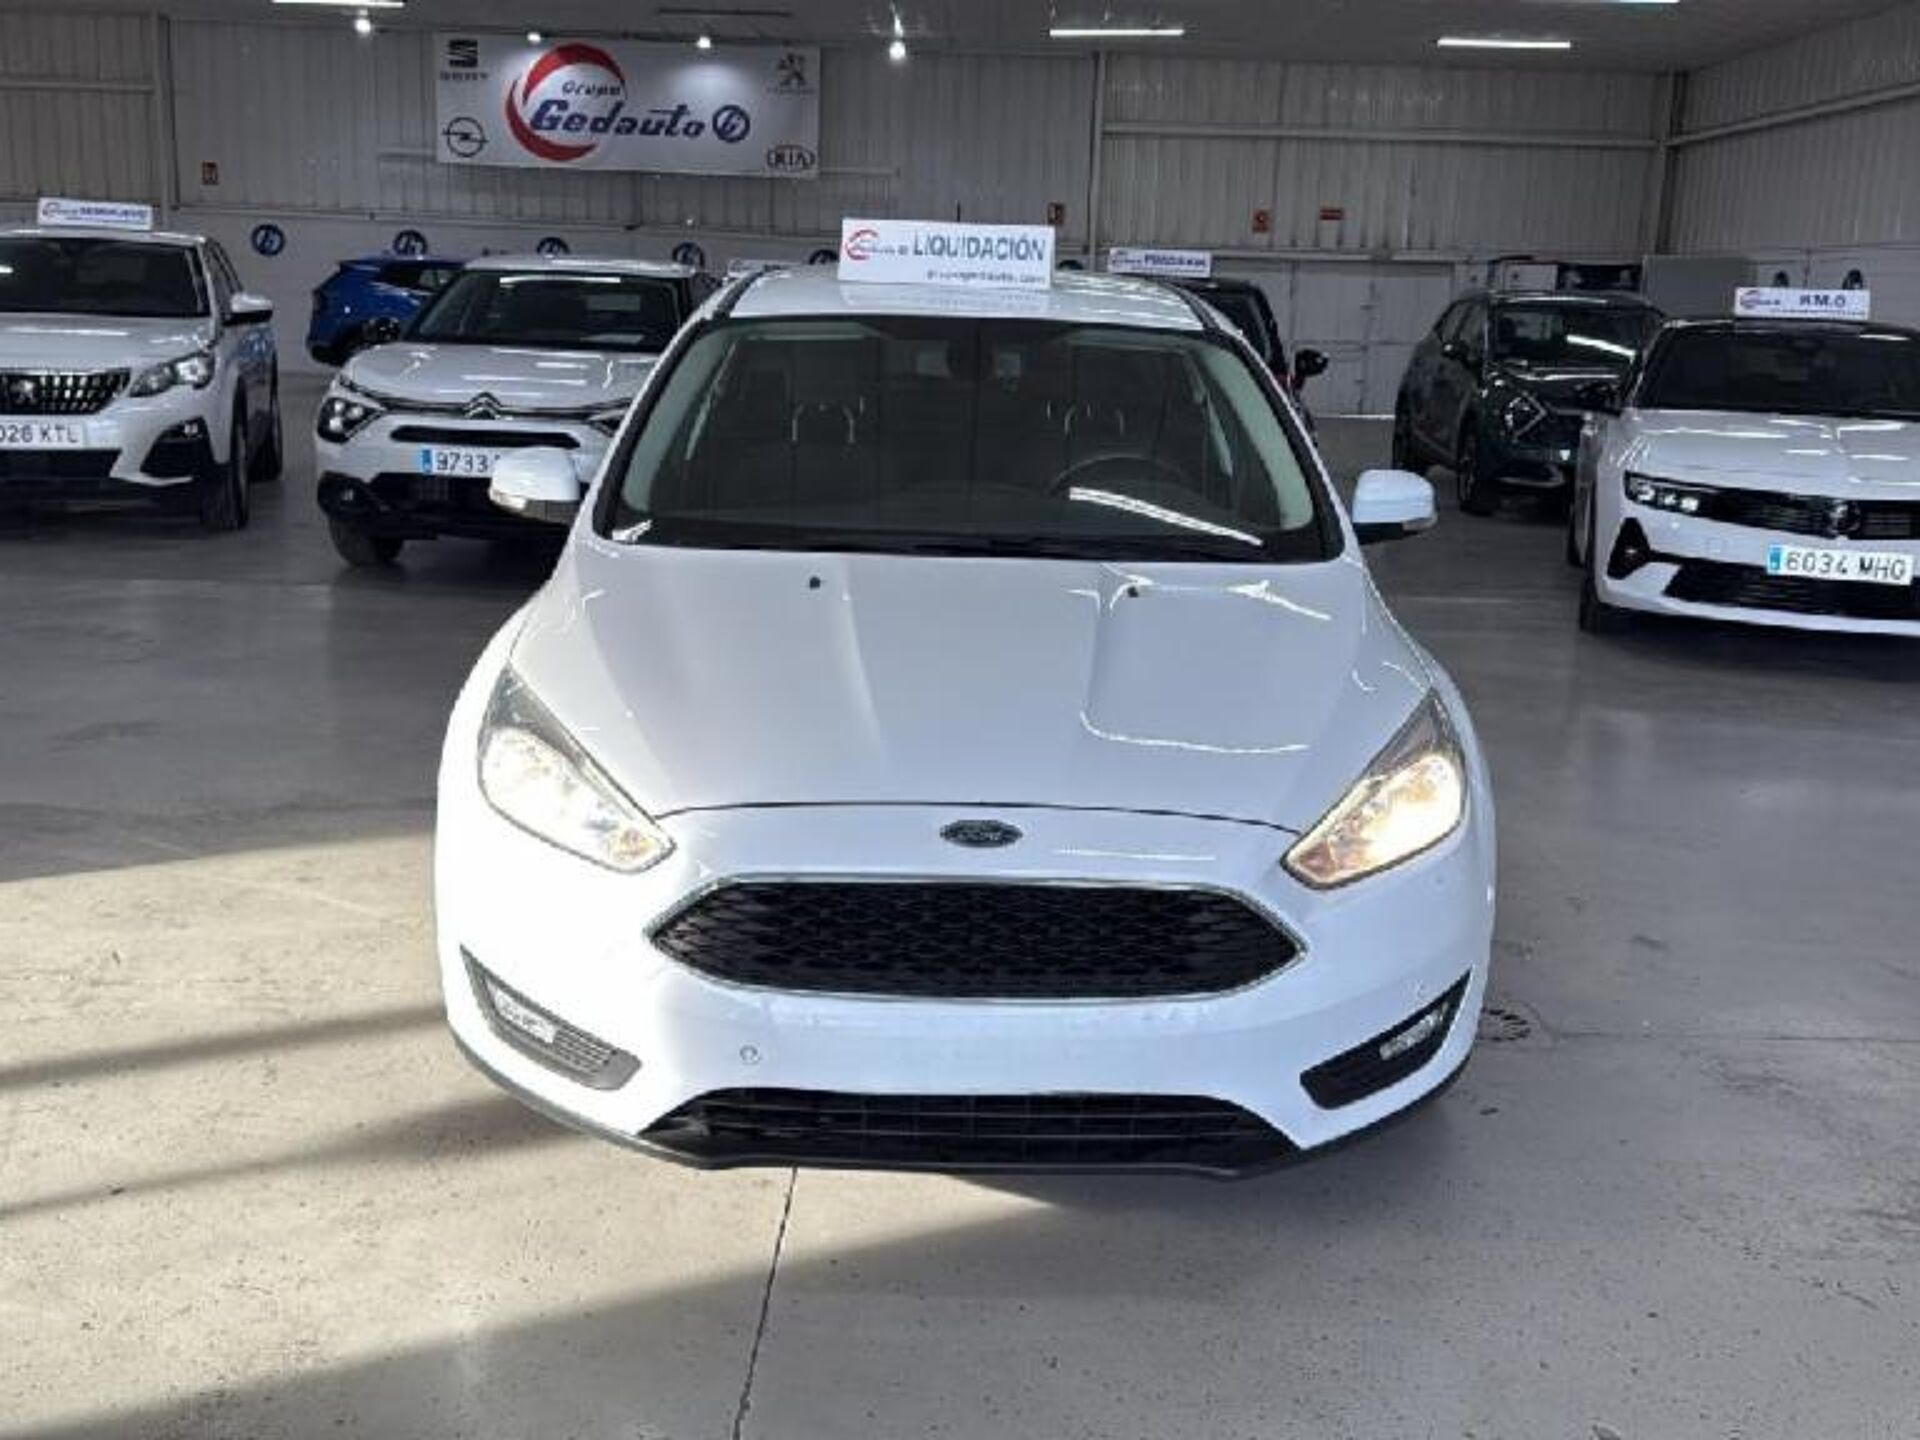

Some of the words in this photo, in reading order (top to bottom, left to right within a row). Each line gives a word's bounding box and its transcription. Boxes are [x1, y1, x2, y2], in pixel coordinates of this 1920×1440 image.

[530, 99, 705, 138] Gedauto
[912, 229, 1046, 261] LIQUIDACIÓN
[40, 422, 79, 443] KTL
[436, 451, 488, 473] 9733
[1785, 550, 1848, 575] 6034
